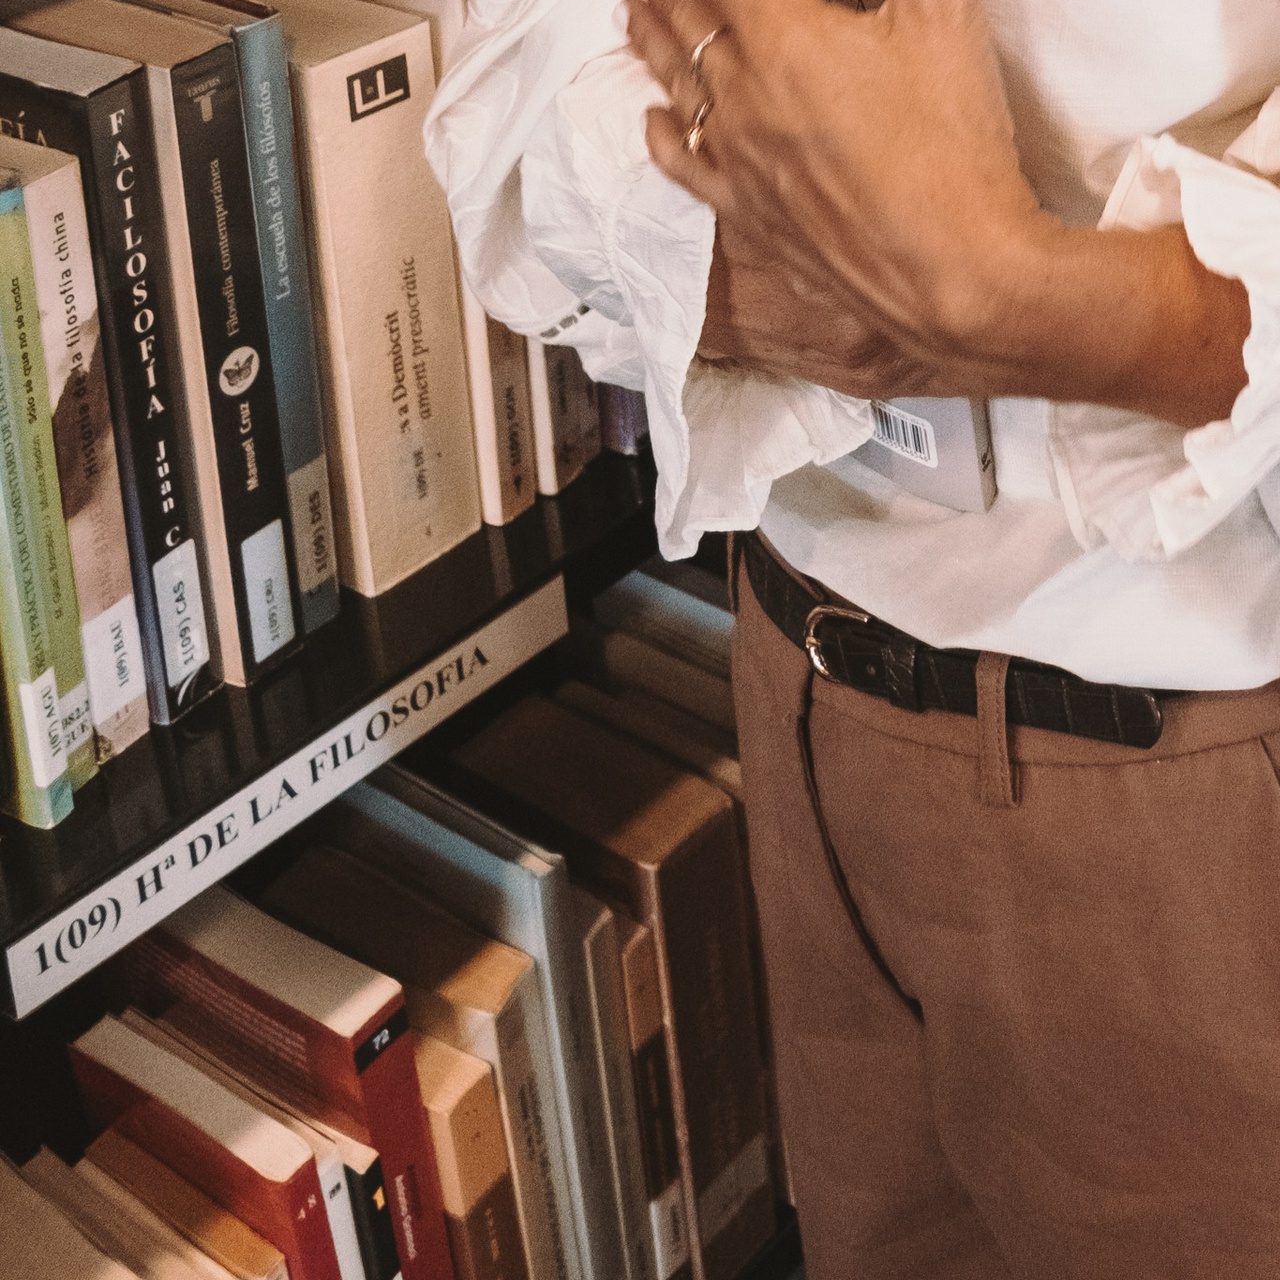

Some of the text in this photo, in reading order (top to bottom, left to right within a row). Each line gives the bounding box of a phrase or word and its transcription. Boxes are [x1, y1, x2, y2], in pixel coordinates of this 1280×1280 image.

[260, 81, 288, 300] La escuela de los filósofos
[54, 211, 70, 263] china
[108, 109, 166, 419] FACILOSOFÍA
[210, 158, 241, 337] Filosofía contemporánea
[11, 276, 23, 312] nada
[59, 268, 81, 348] filosofía
[18, 331, 28, 349] no
[20, 351, 33, 376] que
[70, 351, 83, 371] la
[384, 310, 407, 400] Demòcrit
[401, 256, 432, 420] ament presocràtic
[155, 440, 176, 515] Juan
[239, 400, 259, 491] Manuel Cruz
[110, 619, 124, 651] BAU
[171, 579, 198, 666] 1(09) CAS
[39, 684, 57, 719] AGU
[33, 643, 492, 976] 1(09) Hª DE LA FILOSOFIA
